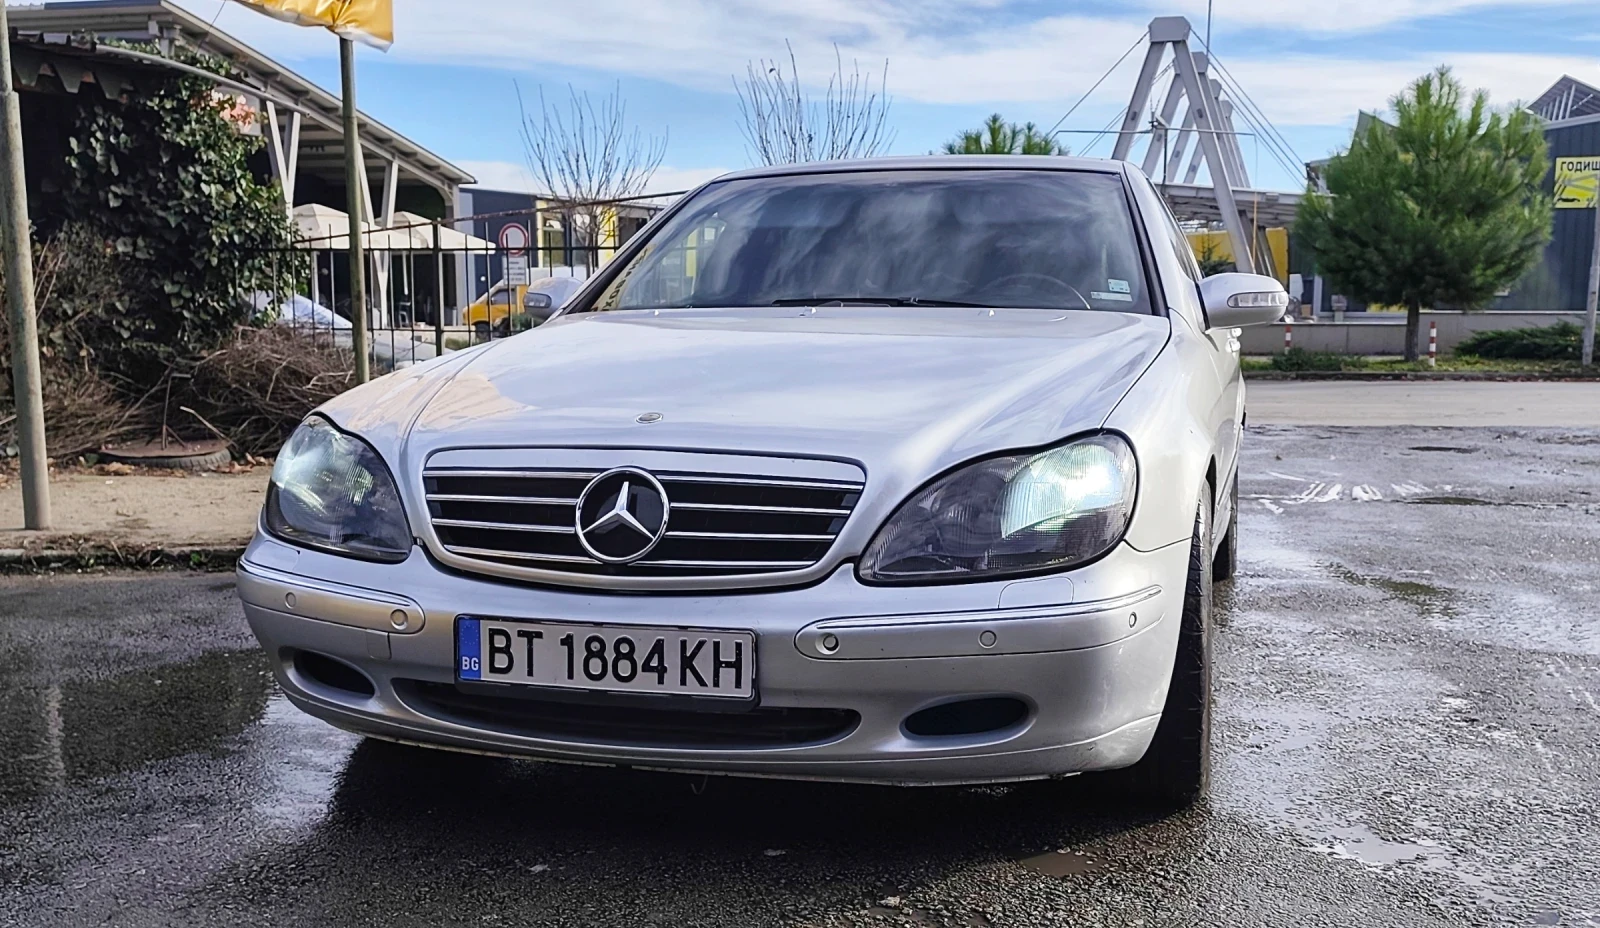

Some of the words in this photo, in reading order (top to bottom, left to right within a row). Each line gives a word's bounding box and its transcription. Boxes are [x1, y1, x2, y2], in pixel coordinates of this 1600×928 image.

[461, 656, 479, 671] BG
[488, 628, 543, 677] BT
[559, 633, 668, 685] 1884
[679, 638, 743, 689] KH
